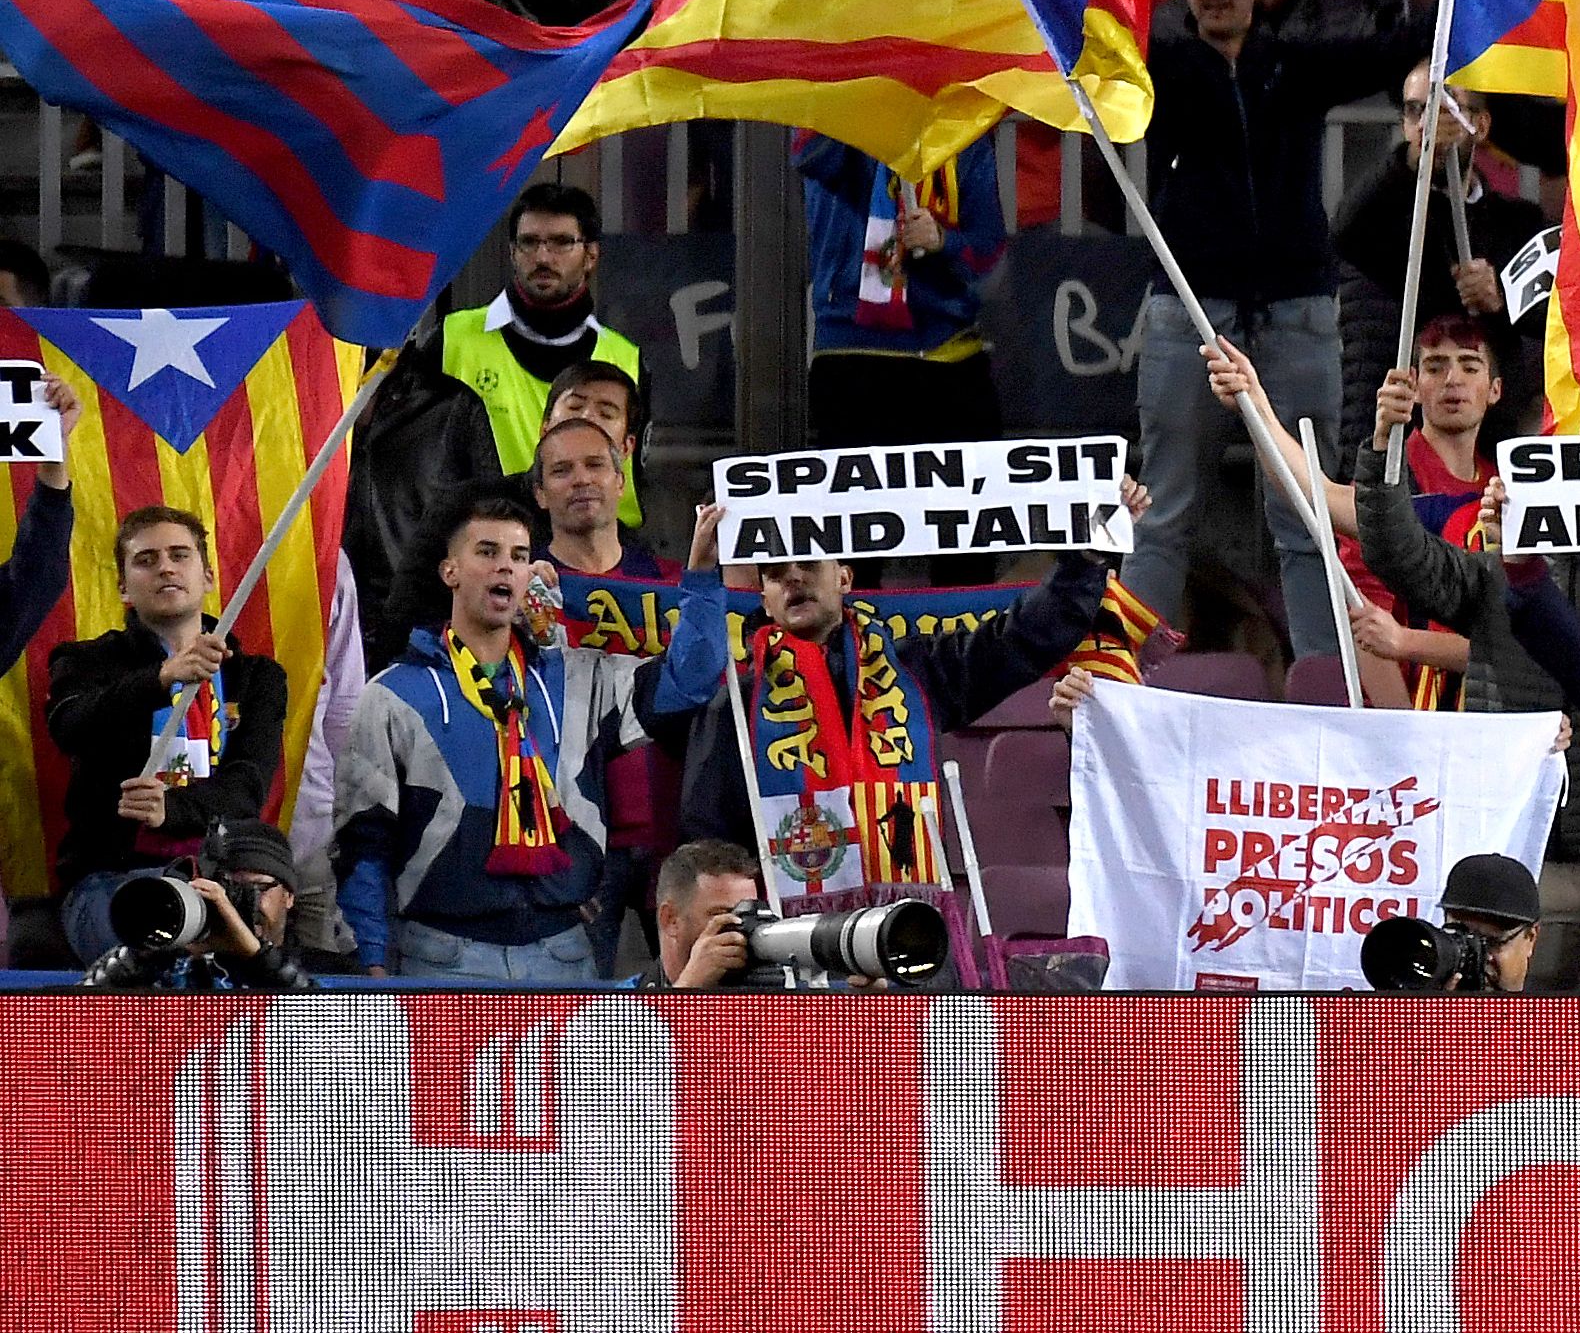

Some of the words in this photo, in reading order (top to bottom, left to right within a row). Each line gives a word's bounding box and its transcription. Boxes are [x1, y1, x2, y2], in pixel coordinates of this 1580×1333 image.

[725, 449, 987, 497] SPAIN,
[1006, 442, 1119, 484] SIT
[732, 511, 906, 559] AND
[923, 502, 1121, 549] TALK
[1206, 778, 1418, 825] LLIBERTAT
[1203, 828, 1418, 886] PRESOS
